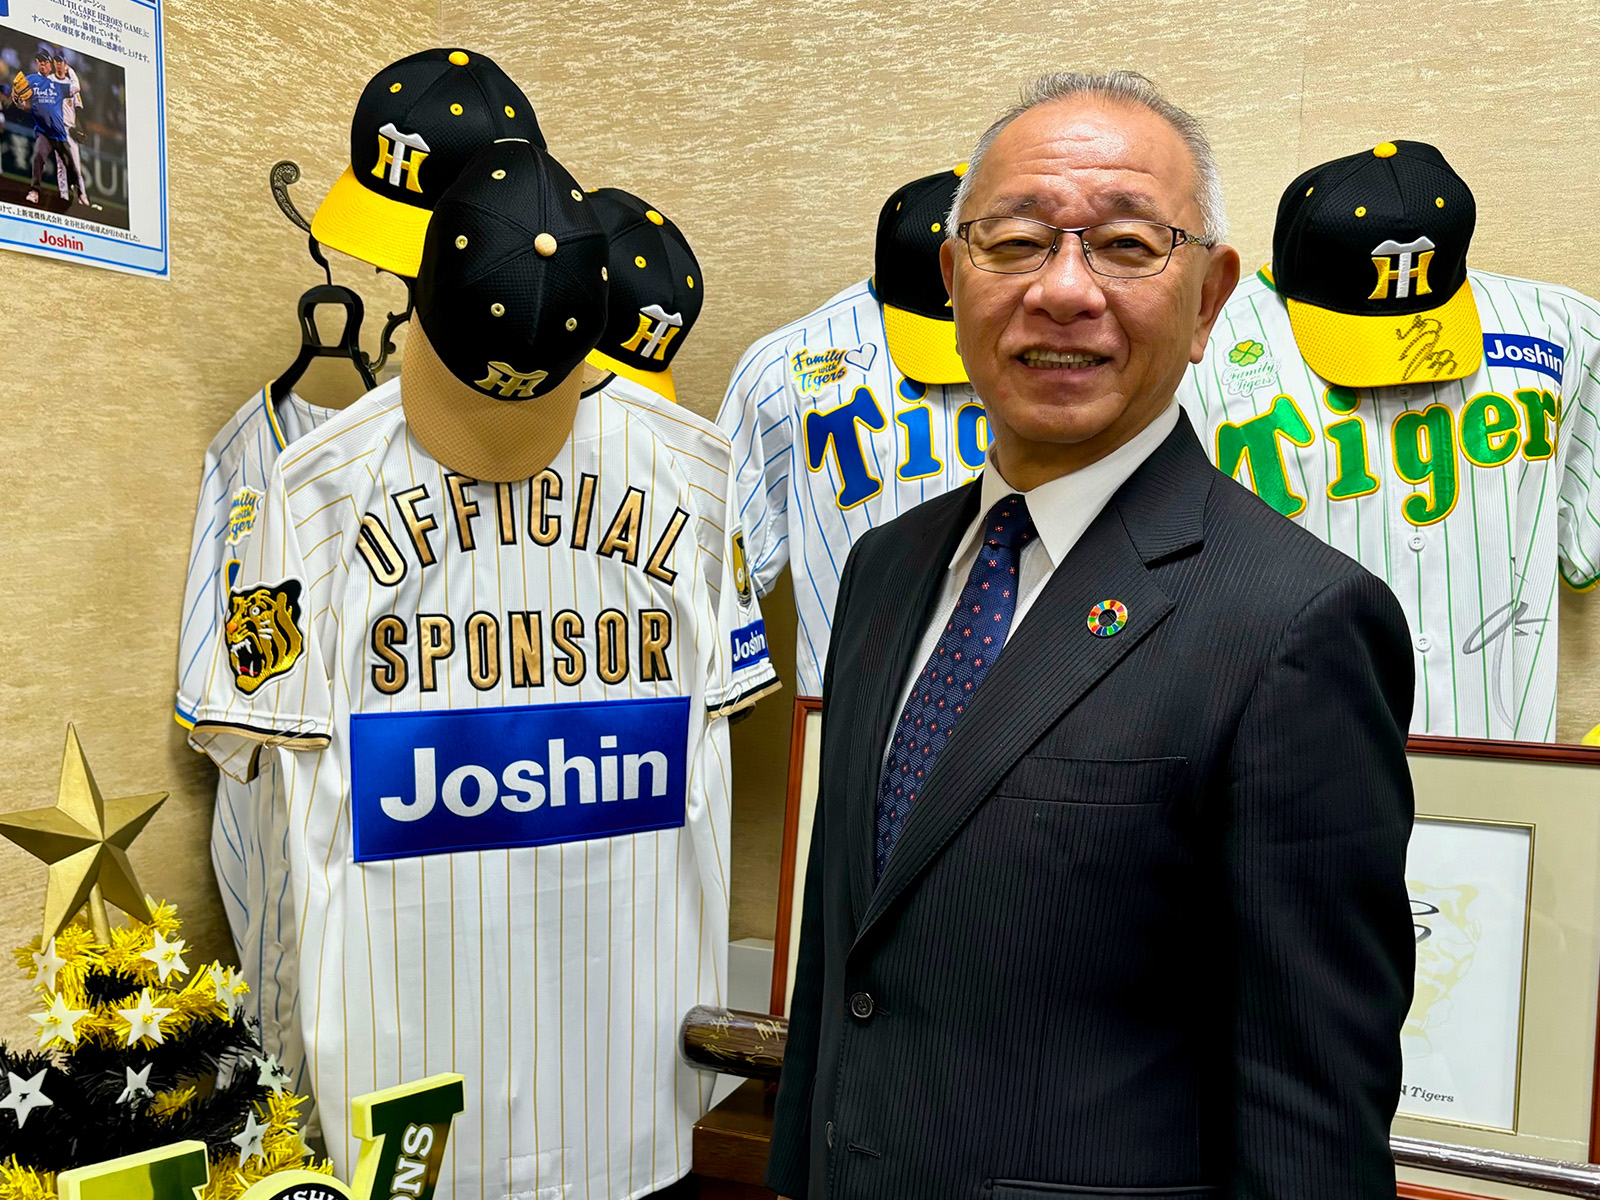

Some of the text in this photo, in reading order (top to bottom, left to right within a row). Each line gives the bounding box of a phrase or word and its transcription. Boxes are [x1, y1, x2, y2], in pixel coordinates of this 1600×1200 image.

[77, 5, 96, 18] CARE
[97, 11, 123, 28] HEROES
[39, 230, 84, 251] Joshin
[792, 348, 847, 373] Family
[818, 363, 837, 374] with
[1486, 339, 1563, 376] Joshin
[796, 367, 847, 393] Tigers
[1214, 385, 1563, 527] Tiger
[355, 466, 691, 588] OFFICIAL
[371, 607, 673, 695] SPONSOR
[379, 734, 669, 823] Joshin
[1410, 1085, 1455, 1103] Tigers
